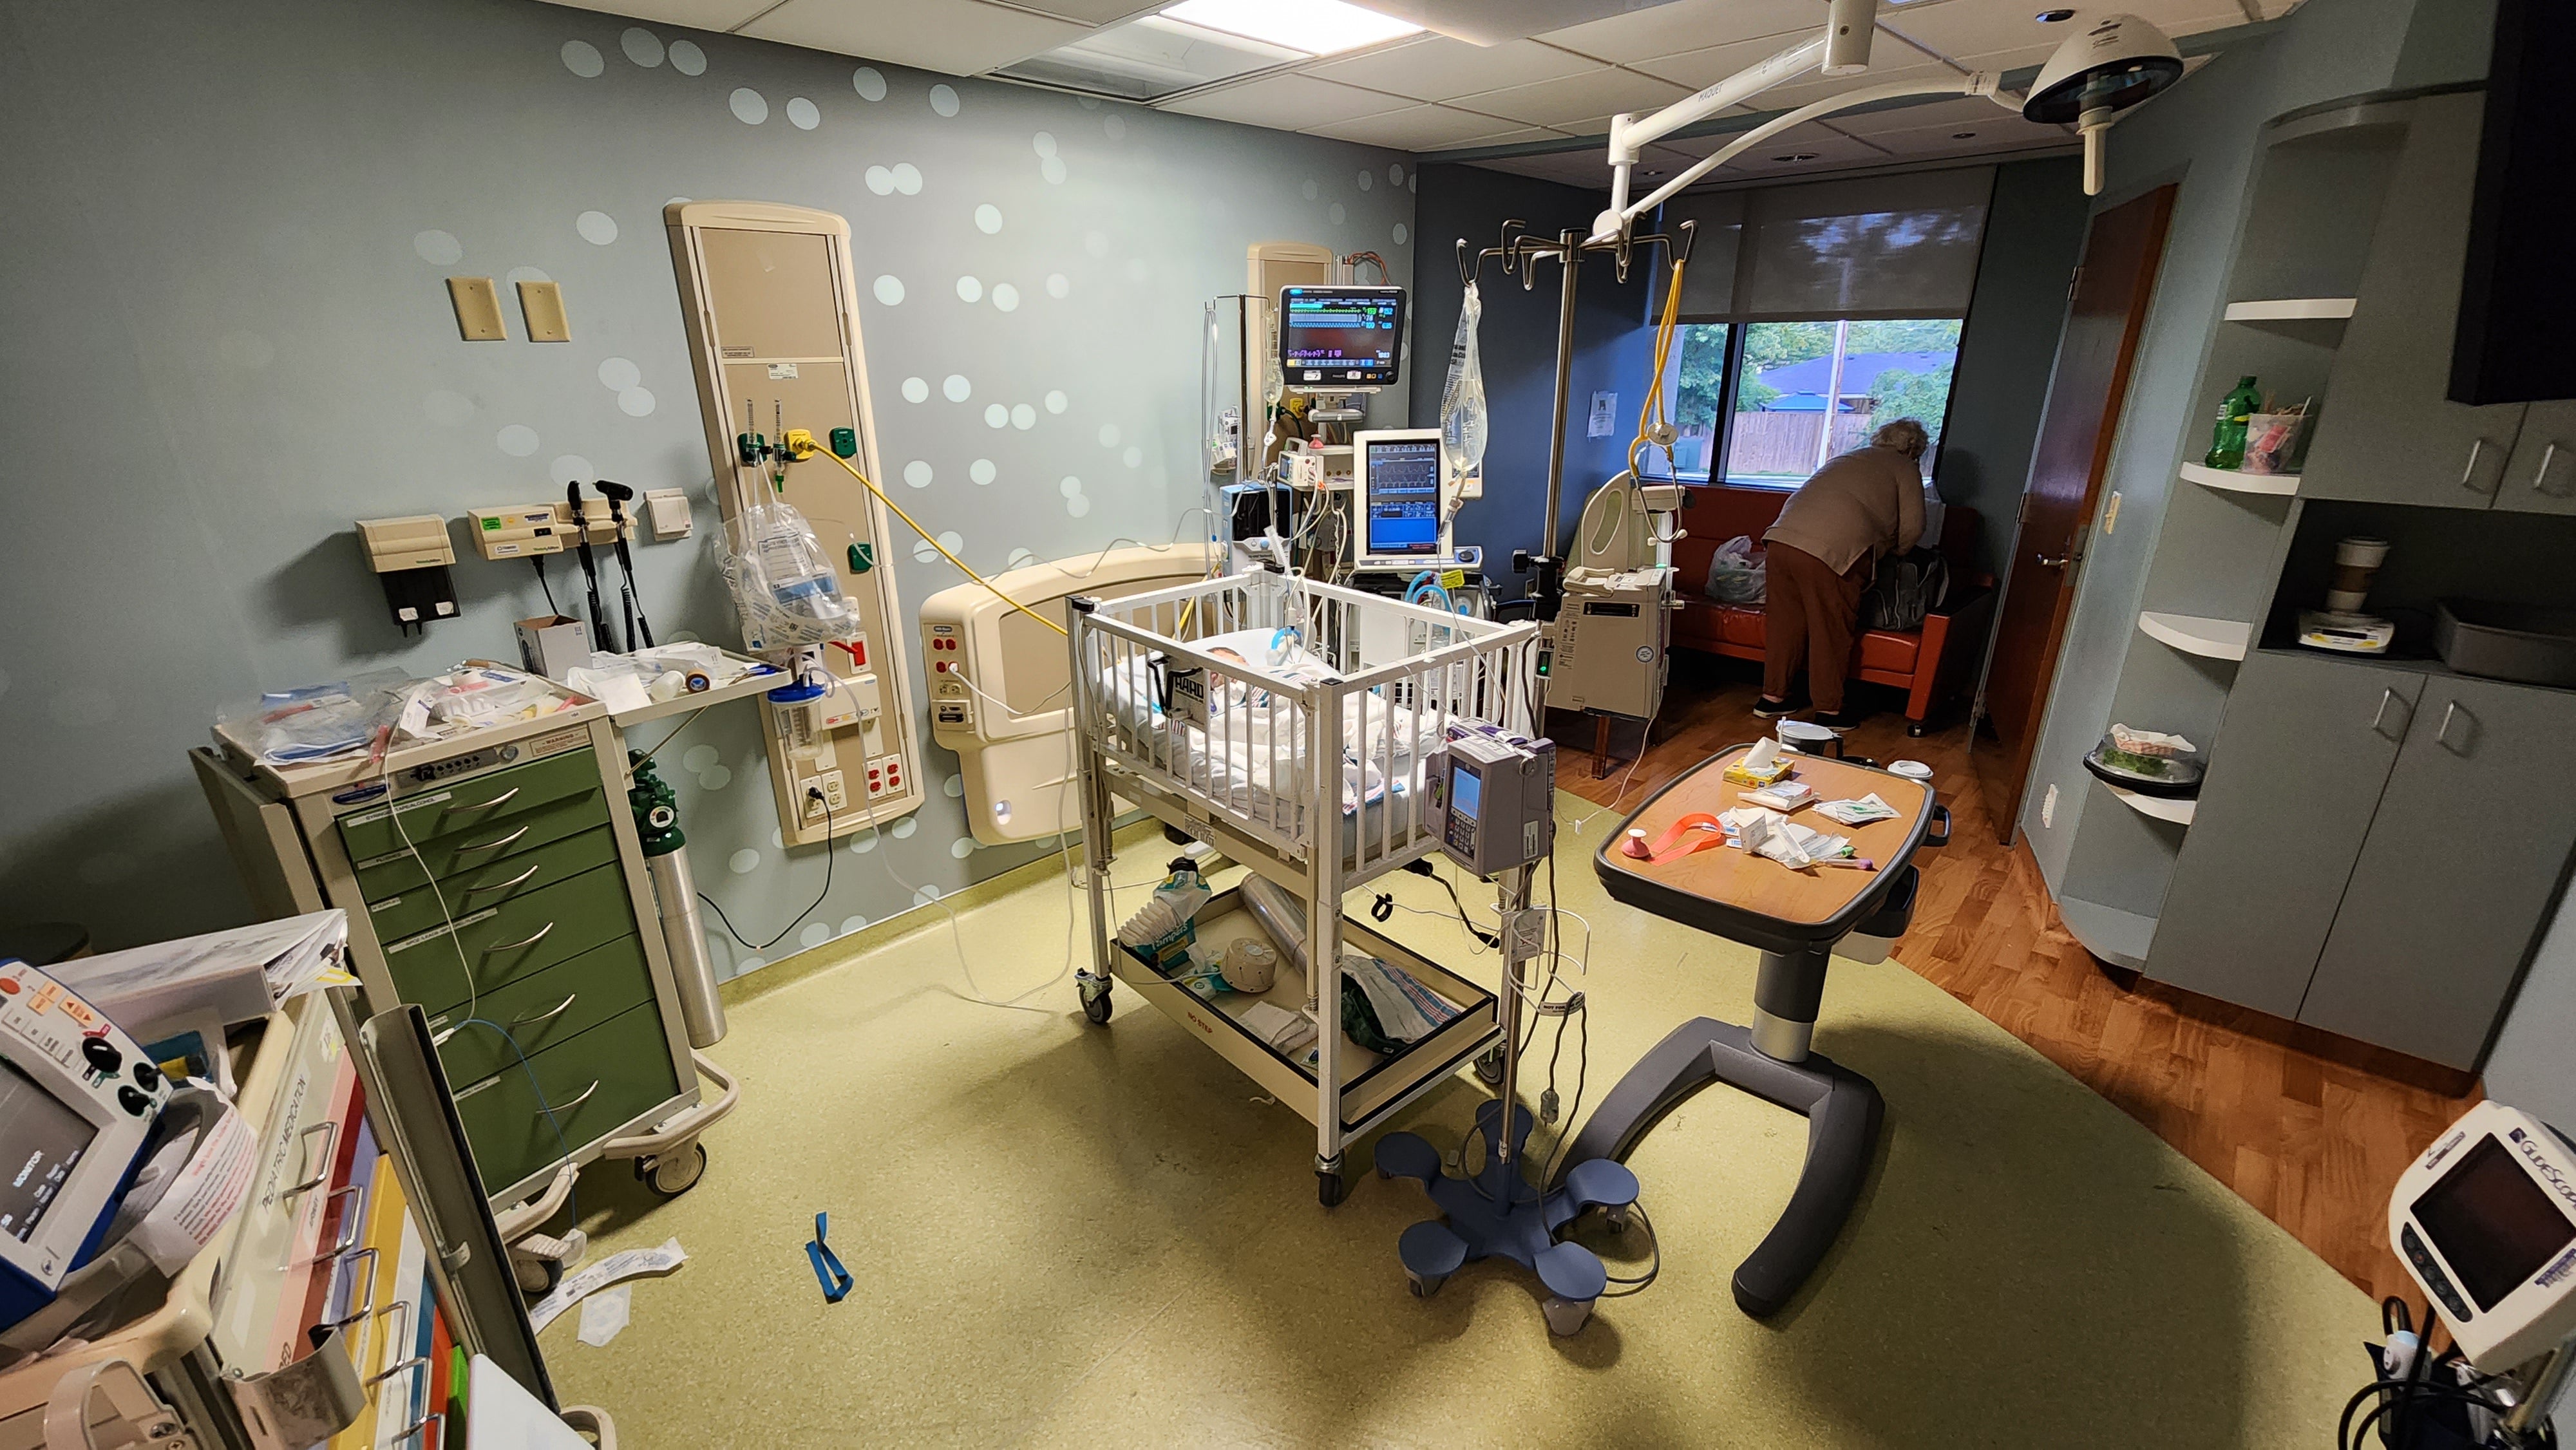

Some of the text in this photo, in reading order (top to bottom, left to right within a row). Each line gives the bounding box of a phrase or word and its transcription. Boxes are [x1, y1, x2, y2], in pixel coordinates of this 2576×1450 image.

[1698, 83, 1723, 102] MAQUET
[1188, 1012, 1213, 1034] NO STEP
[262, 1075, 307, 1214] PEDIATRIC MEDICATION
[12, 1150, 44, 1187] MONITOR
